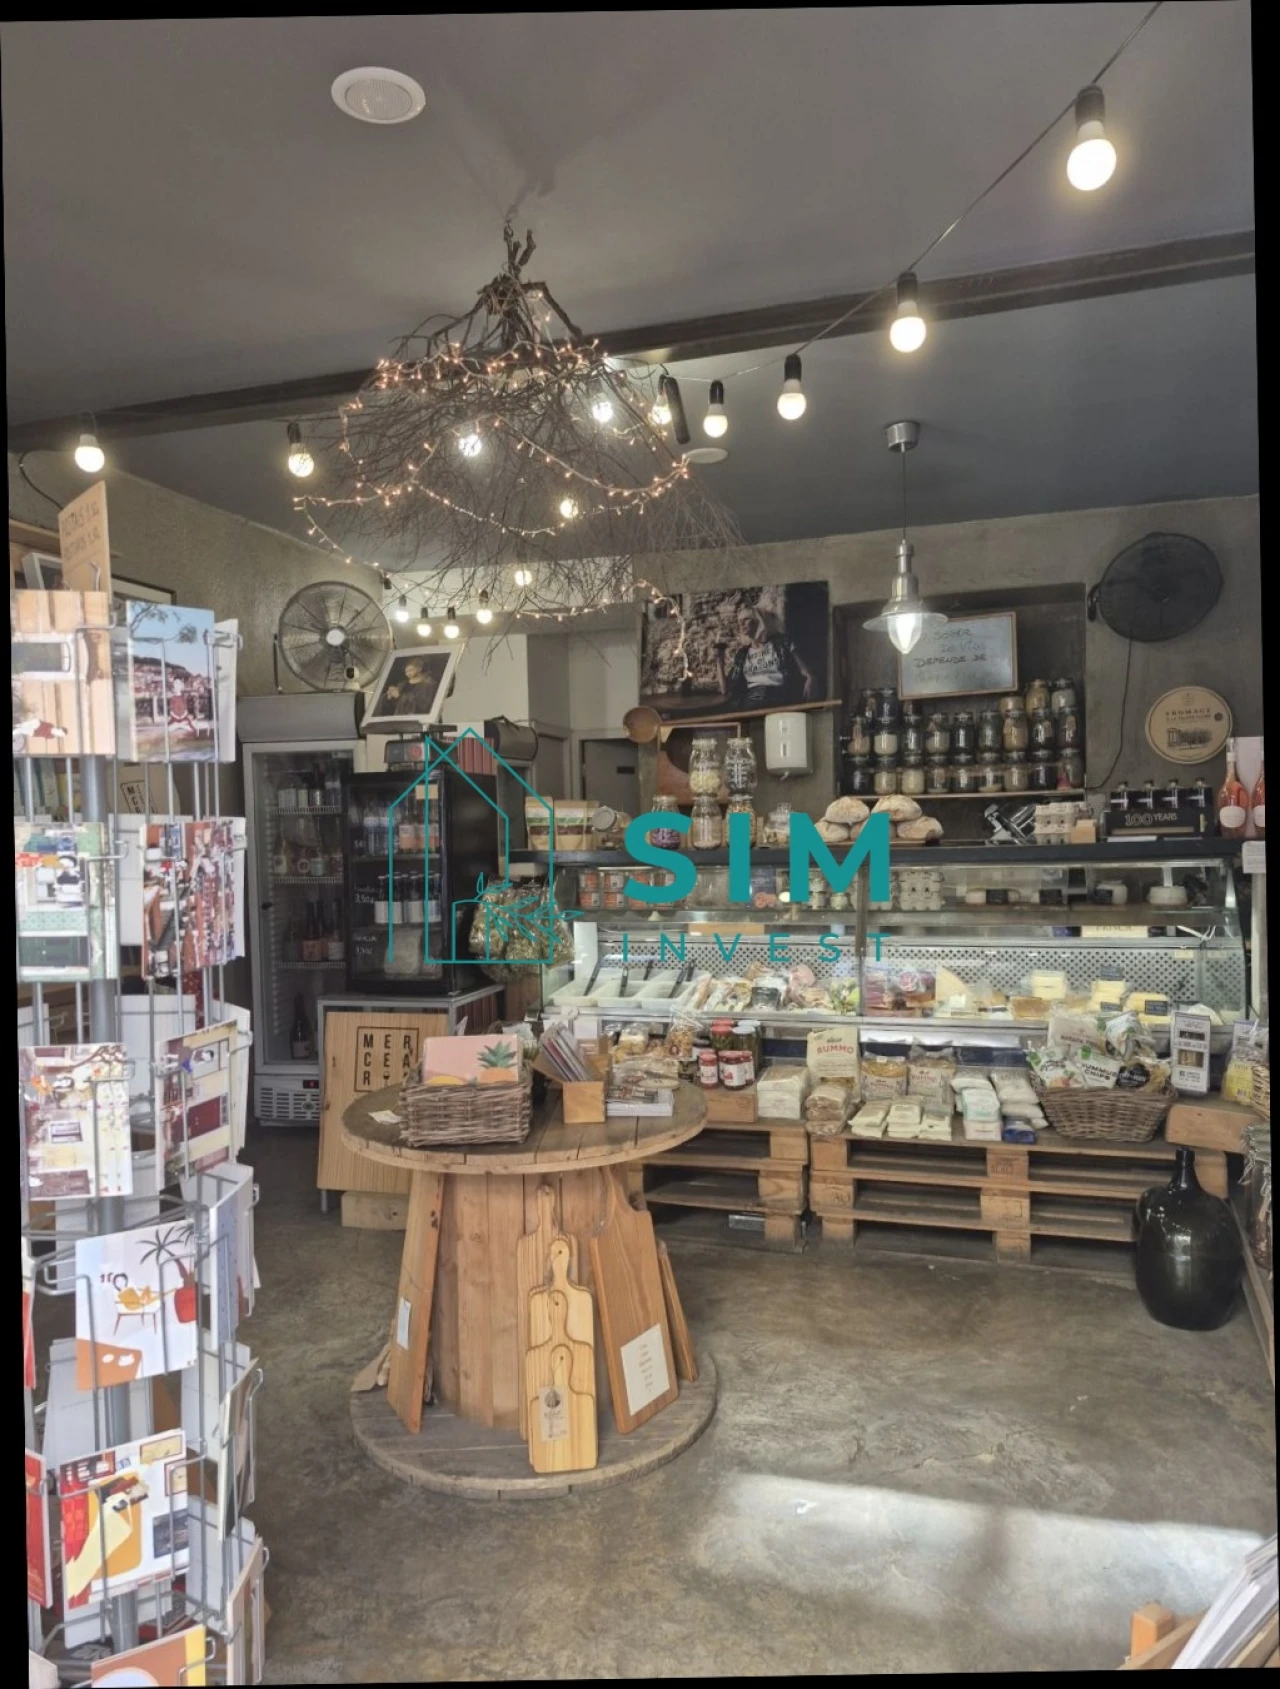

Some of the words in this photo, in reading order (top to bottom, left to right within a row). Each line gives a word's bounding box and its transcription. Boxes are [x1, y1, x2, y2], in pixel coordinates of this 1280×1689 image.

[1125, 813, 1153, 827] 100
[1154, 812, 1178, 822] YEARS
[816, 1043, 854, 1055] RUMMO
